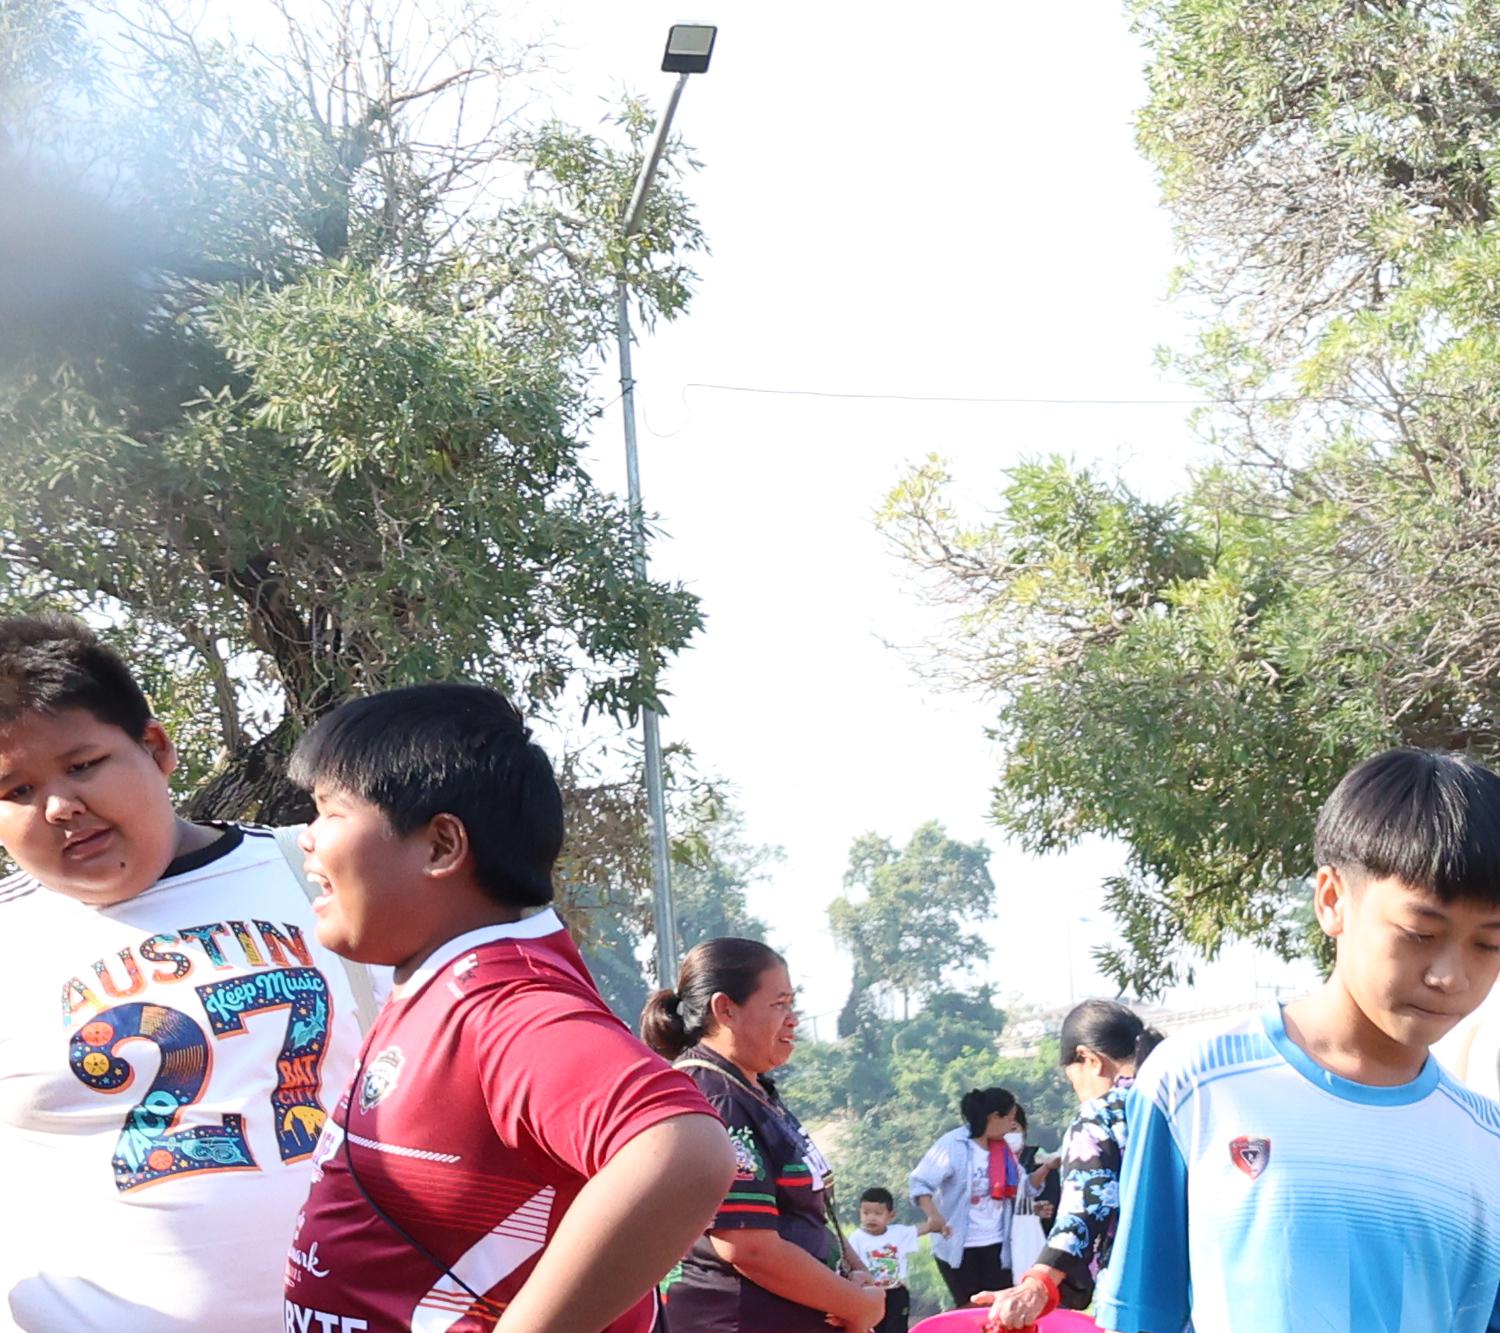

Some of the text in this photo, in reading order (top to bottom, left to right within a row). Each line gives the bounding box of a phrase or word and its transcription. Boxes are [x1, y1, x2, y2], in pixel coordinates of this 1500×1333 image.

[61, 919, 315, 1026] AUSTIN
[207, 971, 325, 1021] Keep Music
[69, 966, 334, 1193] 27
[280, 1055, 318, 1086] BAT
[115, 1091, 178, 1174] TACO
